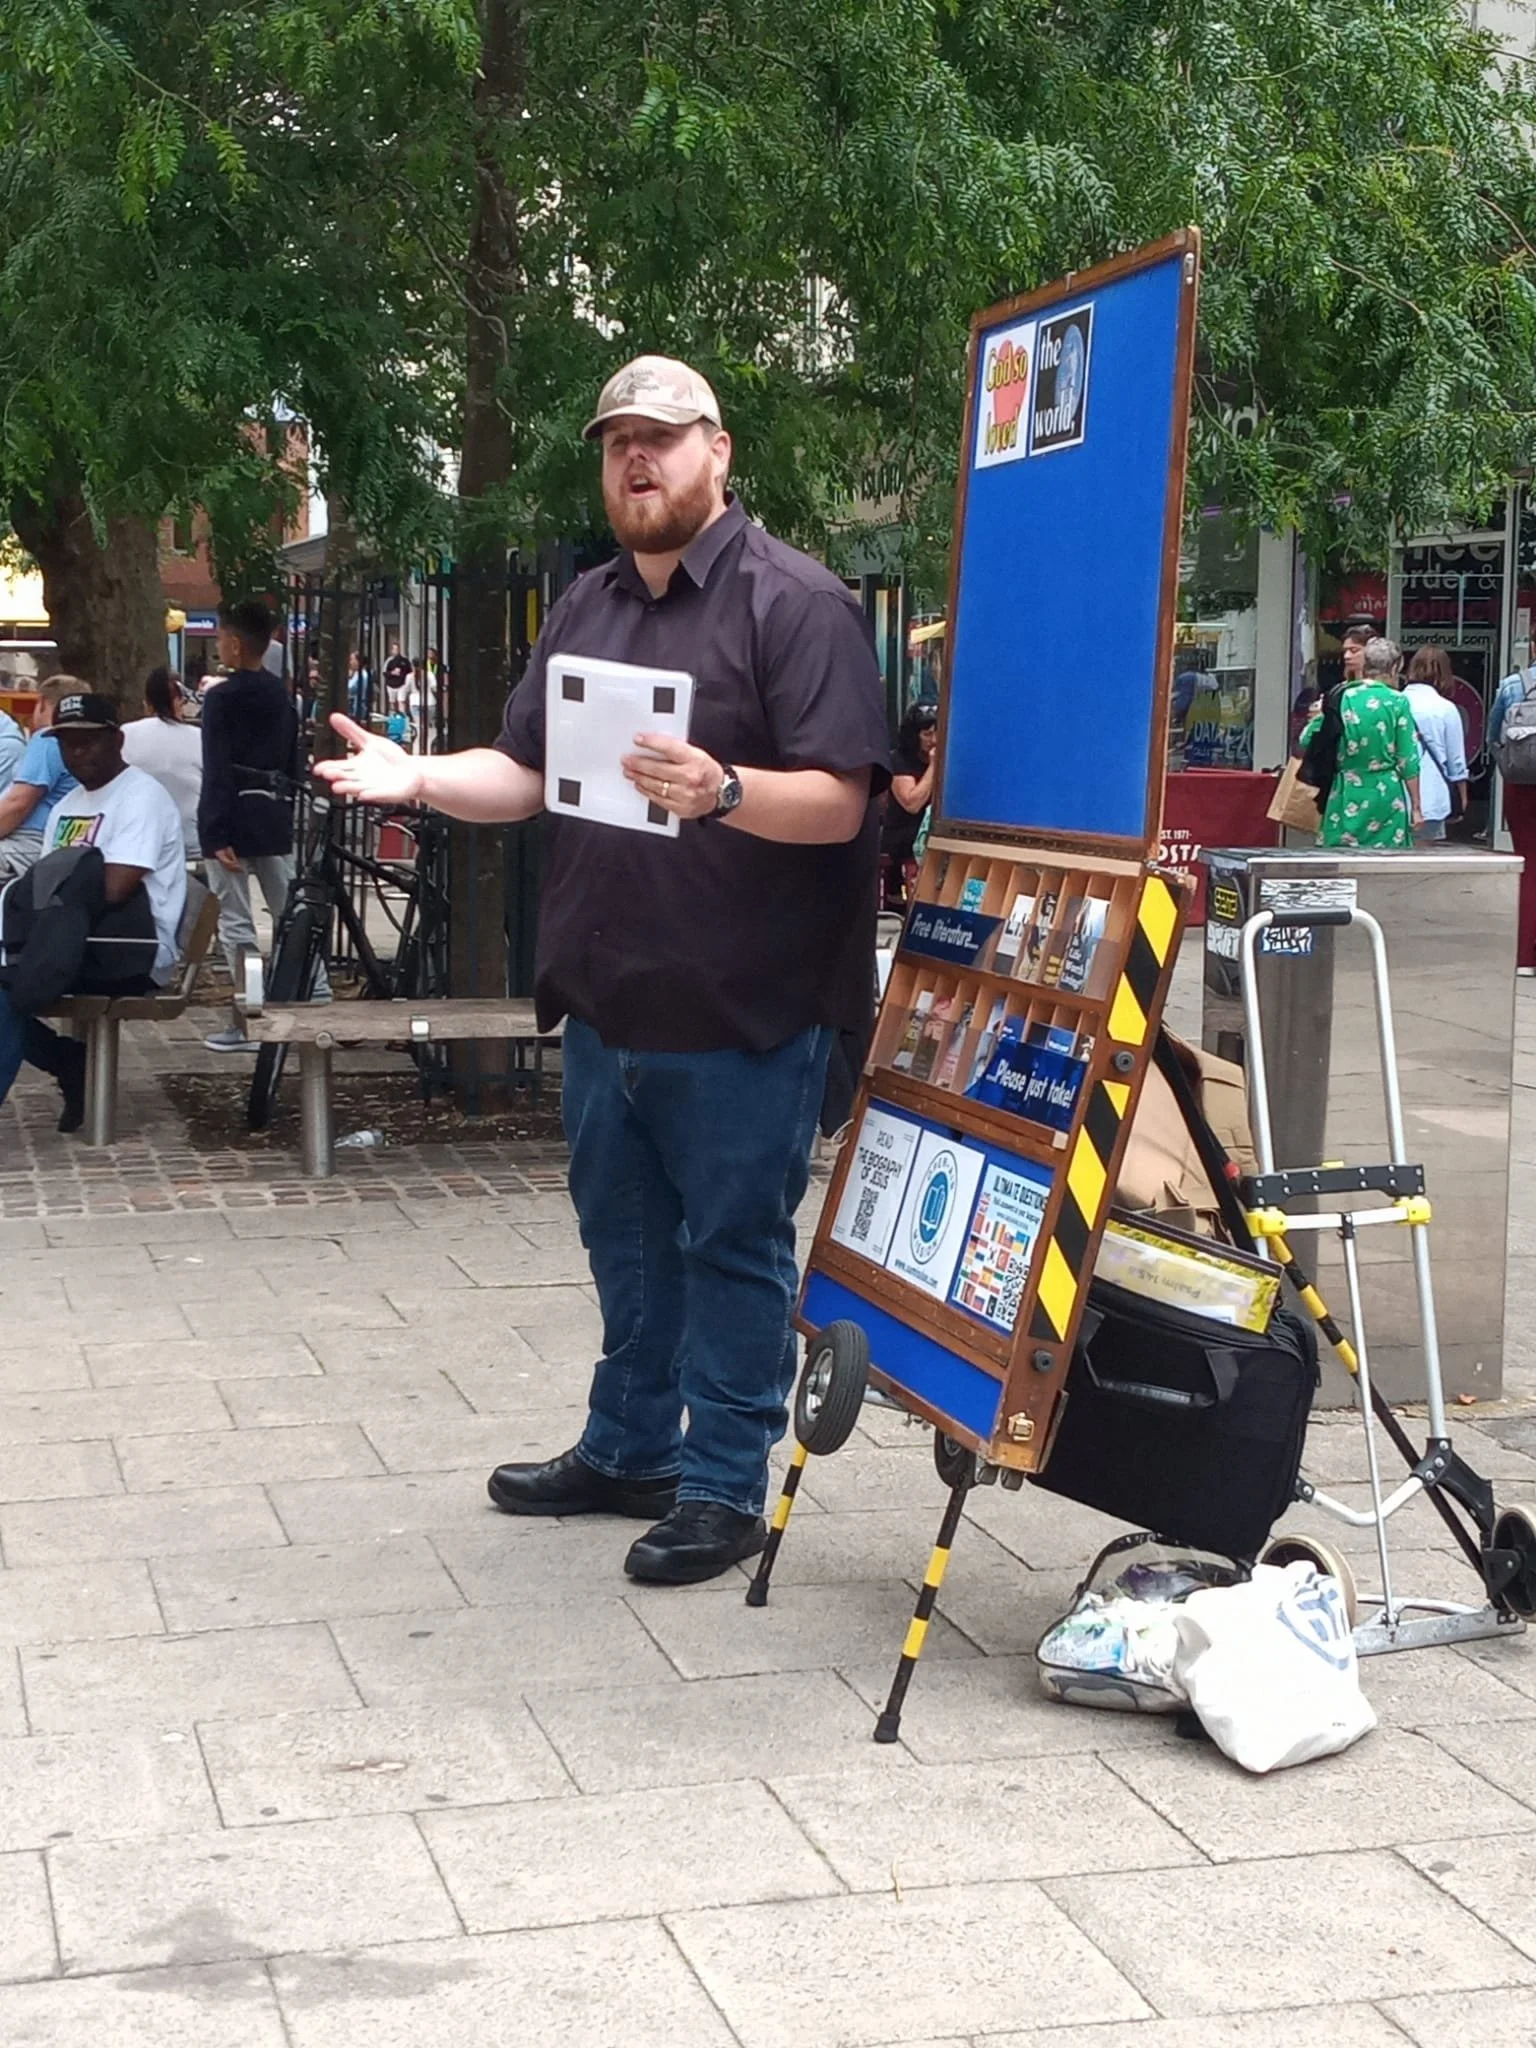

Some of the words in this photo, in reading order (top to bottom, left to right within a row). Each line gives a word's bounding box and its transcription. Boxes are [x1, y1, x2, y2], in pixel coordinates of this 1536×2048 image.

[1039, 326, 1062, 371] the
[986, 347, 1012, 392] God
[1013, 348, 1028, 383] so
[983, 404, 1019, 455] loved
[1034, 387, 1076, 438] world,
[1478, 563, 1497, 590] &
[911, 913, 931, 937] Free
[932, 919, 979, 950] literature...
[1024, 1070, 1047, 1100] just
[1047, 1078, 1075, 1108] take!
[1162, 1276, 1201, 1300] Psalm
